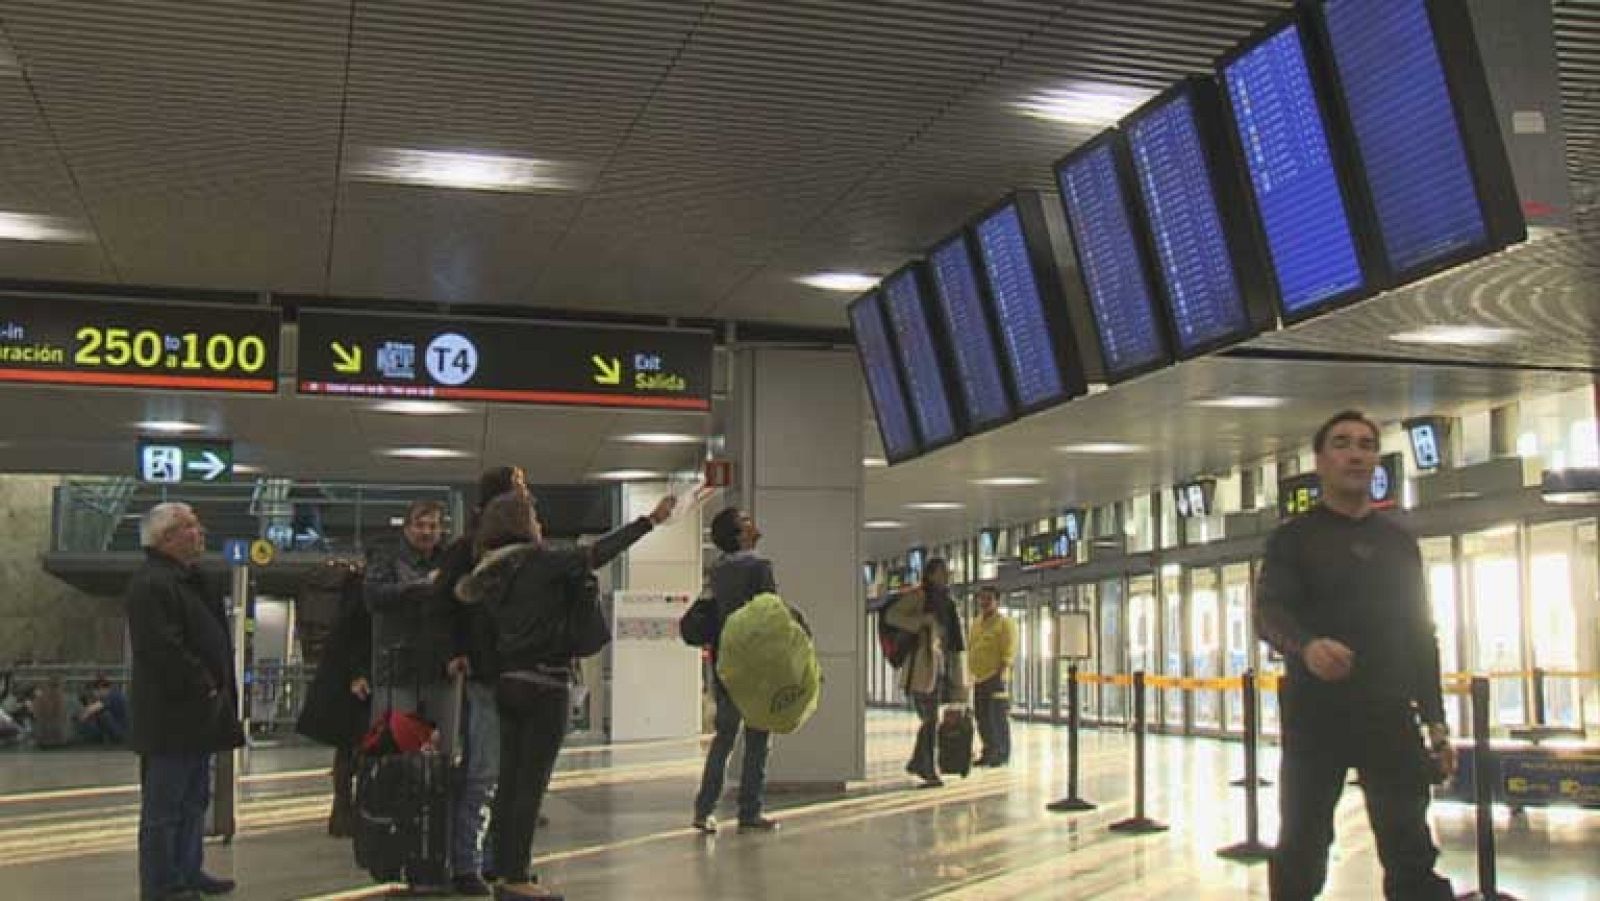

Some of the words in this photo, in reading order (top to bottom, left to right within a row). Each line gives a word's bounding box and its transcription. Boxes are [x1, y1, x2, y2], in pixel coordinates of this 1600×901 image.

[0, 343, 64, 362] ración
[74, 327, 162, 367] 250
[181, 333, 266, 371] 100
[432, 347, 470, 373] T4
[634, 372, 685, 391] Salida
